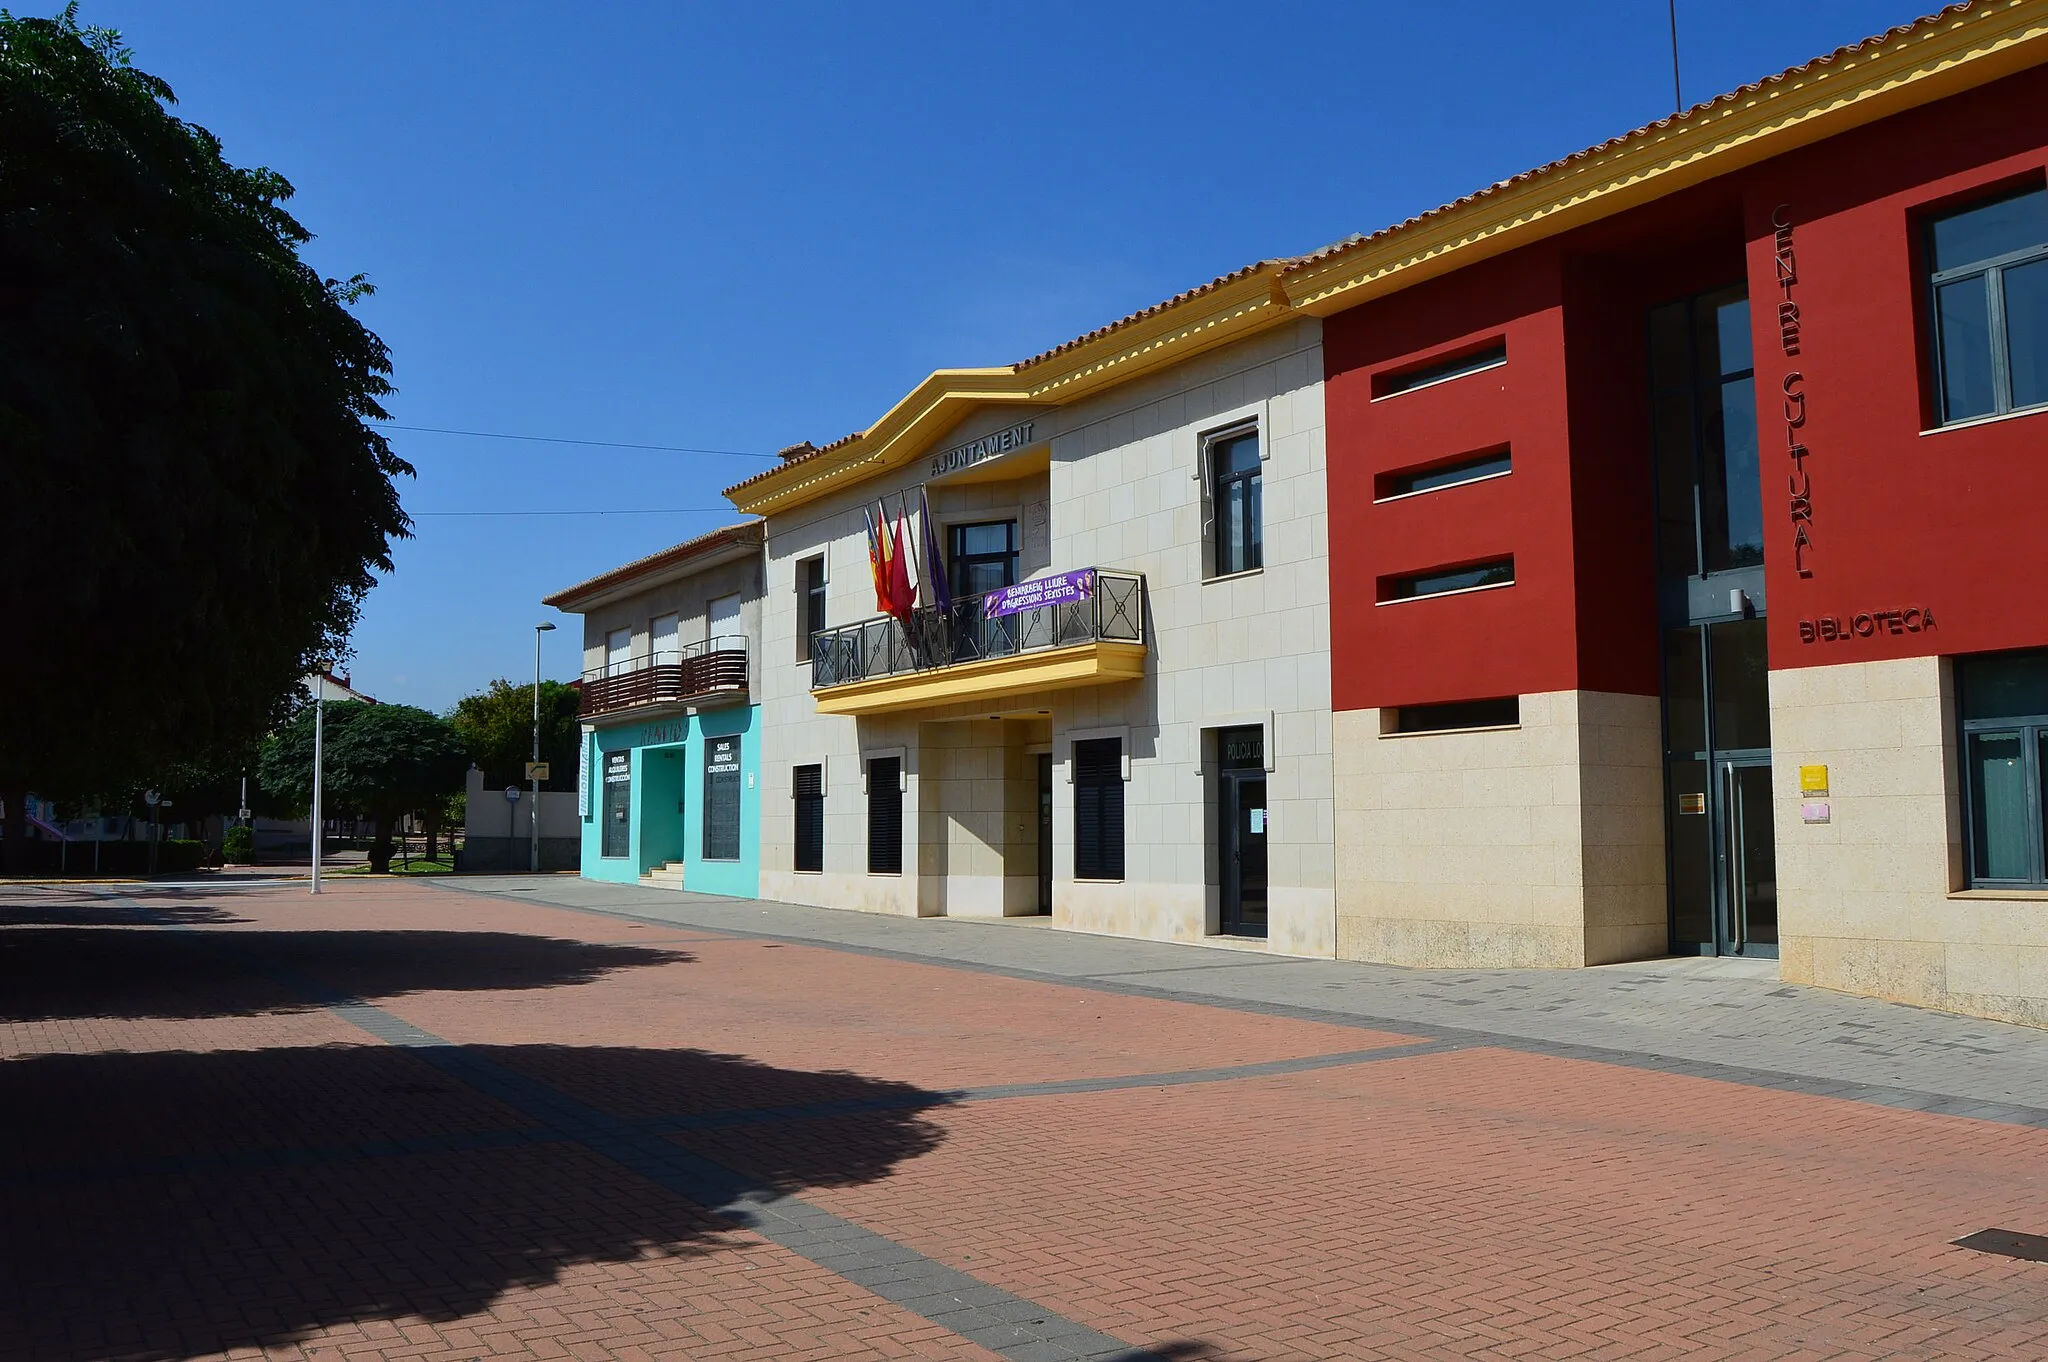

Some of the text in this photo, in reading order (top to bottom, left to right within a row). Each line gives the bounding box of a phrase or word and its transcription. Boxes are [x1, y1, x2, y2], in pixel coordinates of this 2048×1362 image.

[1772, 204, 1811, 574] CENTRE CULTURAL
[931, 423, 1033, 476] AJUNTAMENT
[1044, 576, 1068, 588] LLIURE
[1044, 585, 1075, 600] SEXISTES
[1800, 607, 1938, 642] BIBLIOTECA
[717, 742, 730, 751] SALES
[714, 753, 732, 762] RENTALS
[708, 763, 739, 773] CONSTRUCTION
